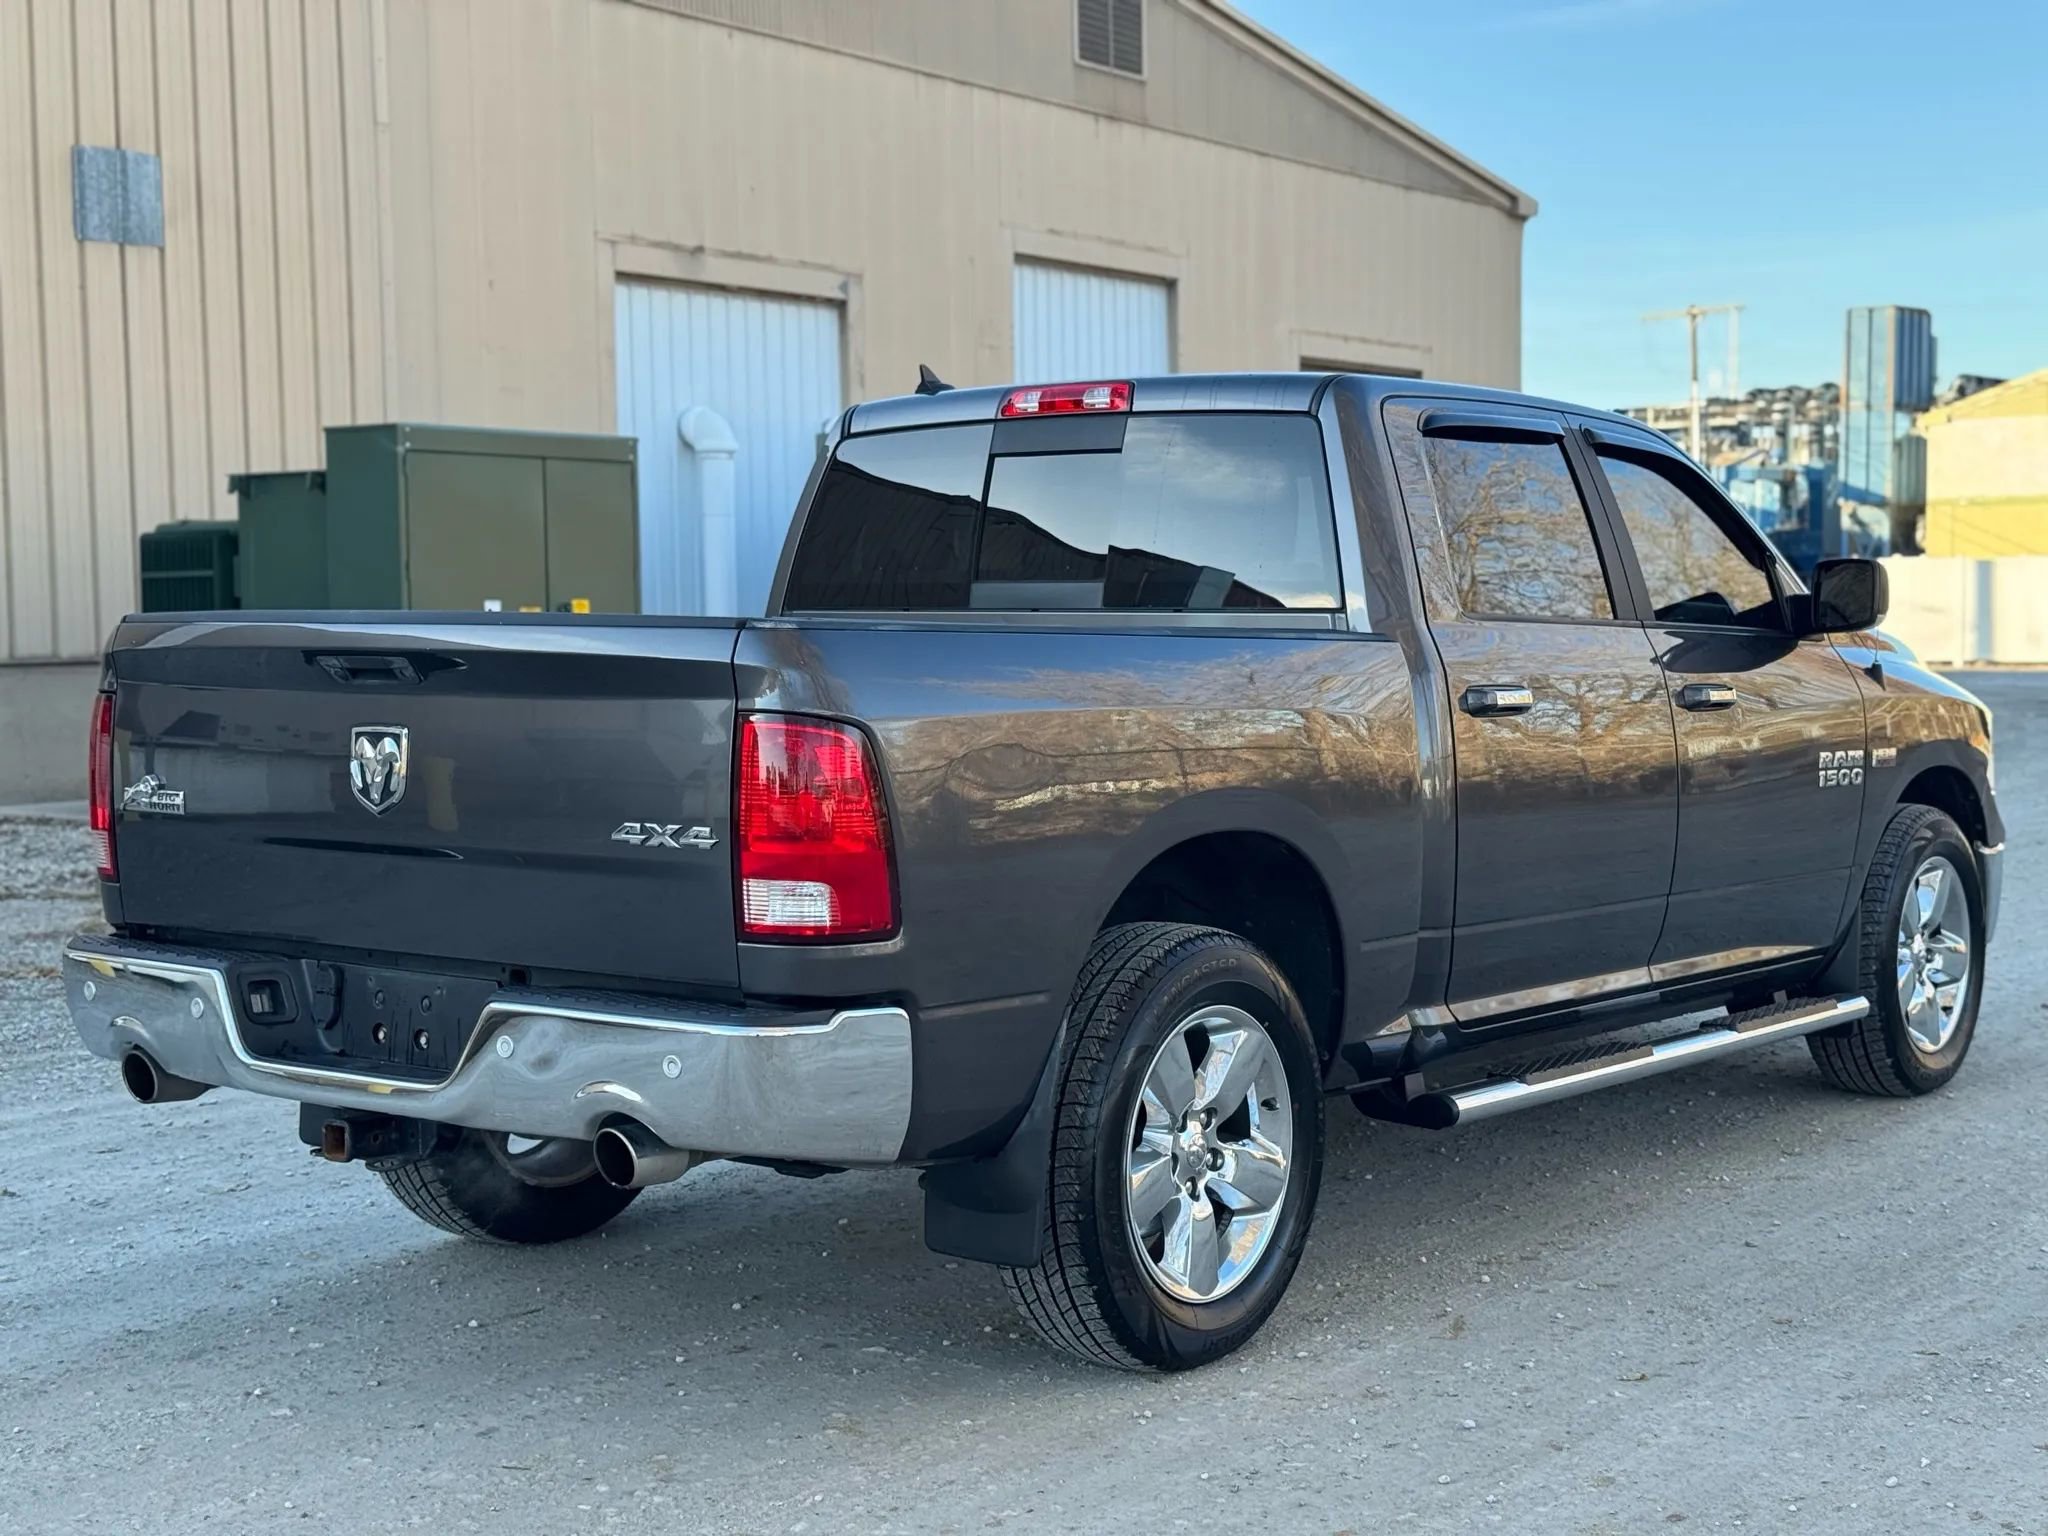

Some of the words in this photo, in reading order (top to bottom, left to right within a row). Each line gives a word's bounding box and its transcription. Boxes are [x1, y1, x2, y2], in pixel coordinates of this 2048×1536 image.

[1819, 750, 1864, 768] RAM
[1819, 768, 1863, 787] 1500
[157, 792, 179, 802] BIG
[150, 802, 180, 811] HORN
